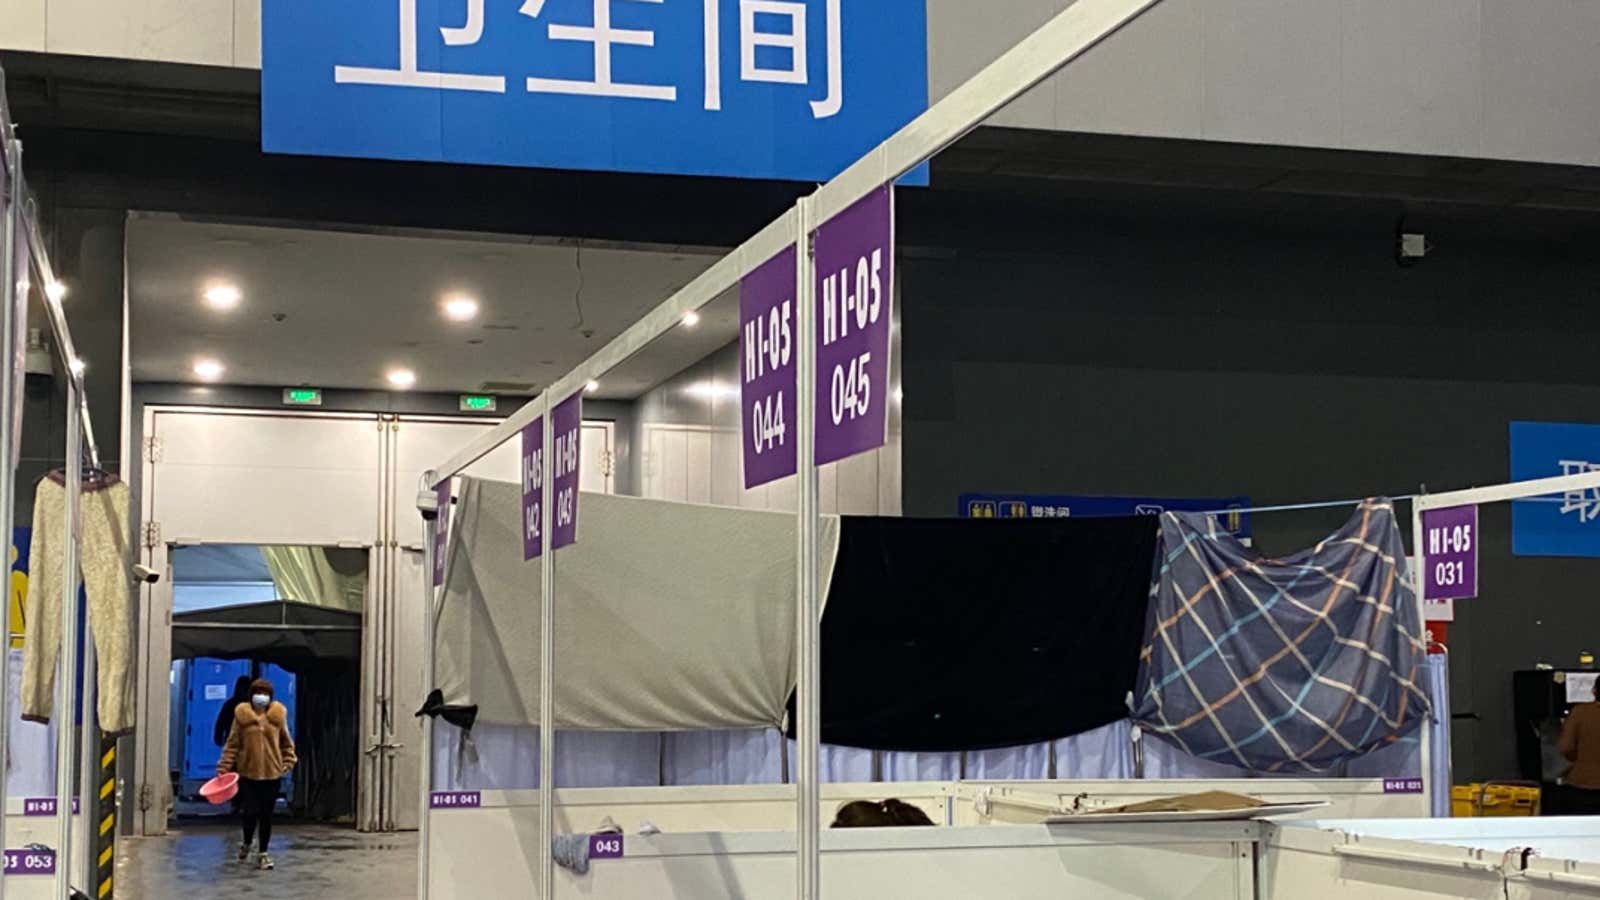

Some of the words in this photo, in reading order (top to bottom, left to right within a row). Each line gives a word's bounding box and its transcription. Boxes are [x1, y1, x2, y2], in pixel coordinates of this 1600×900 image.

[334, 0, 843, 119] 卫生间
[831, 352, 871, 426] 045
[753, 391, 785, 454] 044
[557, 487, 573, 528] 043
[1435, 561, 1464, 586] 031
[460, 795, 477, 804] 041
[25, 854, 52, 869] 053
[596, 840, 620, 853] 043
